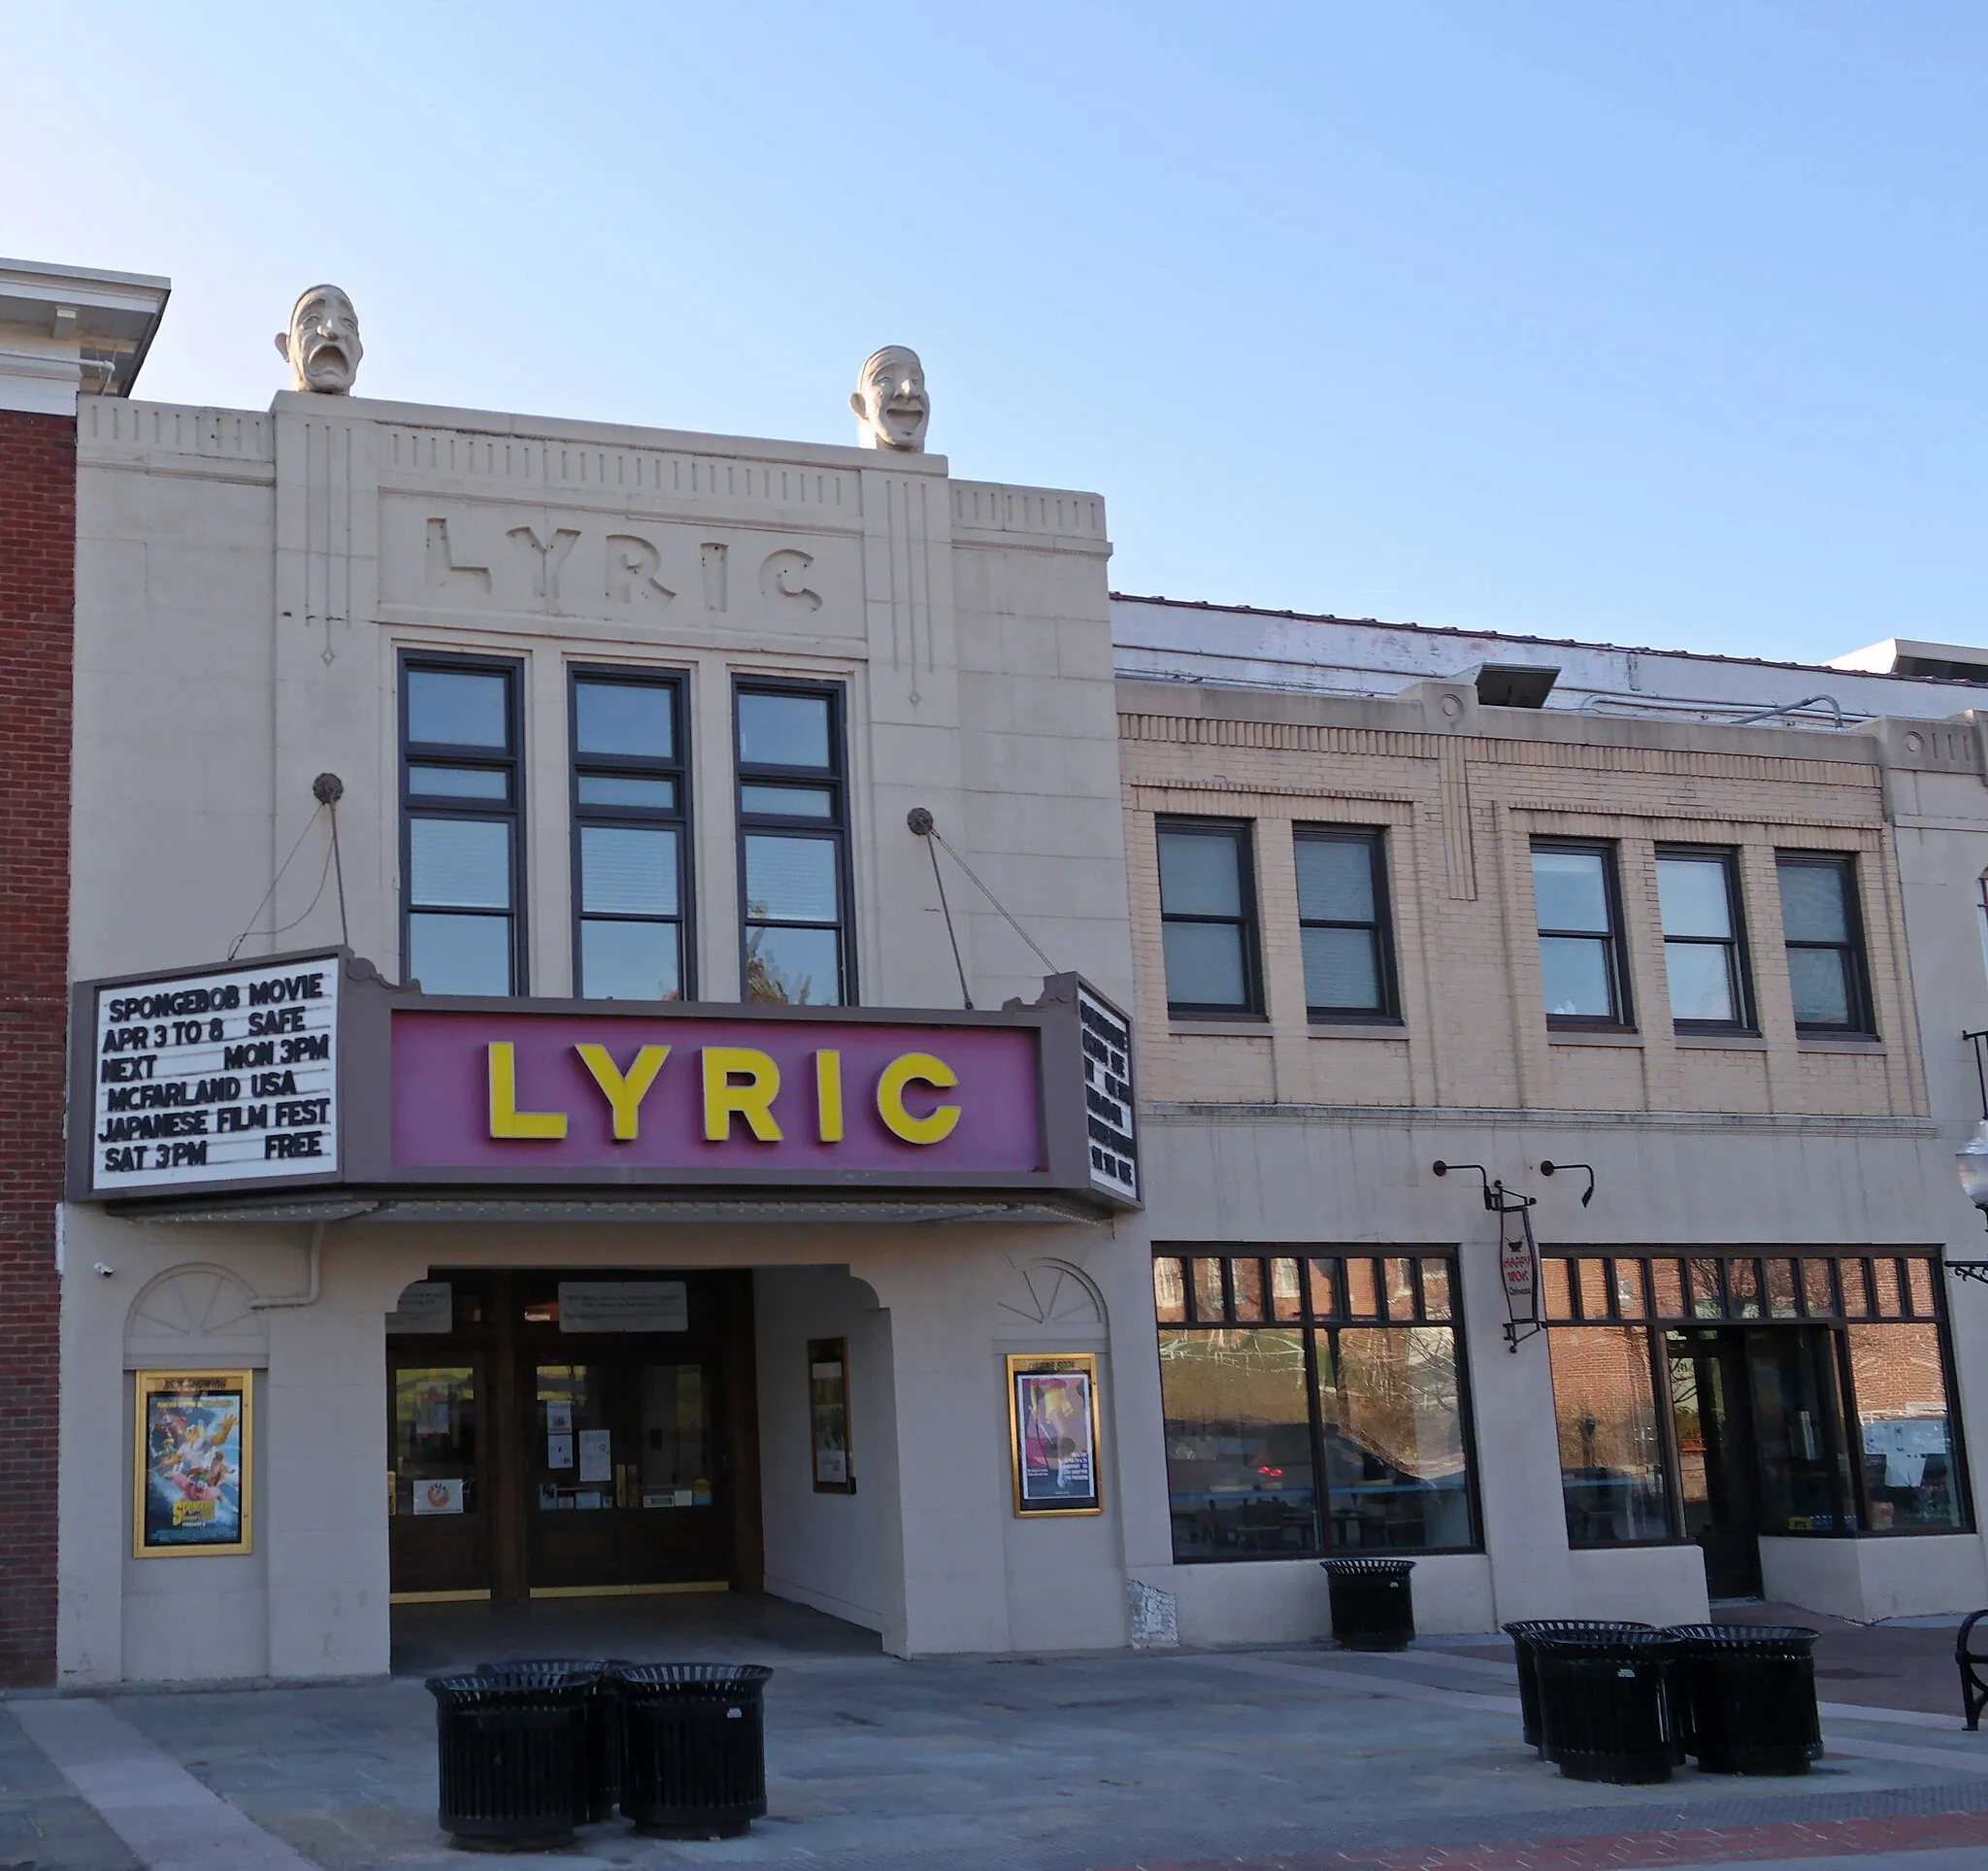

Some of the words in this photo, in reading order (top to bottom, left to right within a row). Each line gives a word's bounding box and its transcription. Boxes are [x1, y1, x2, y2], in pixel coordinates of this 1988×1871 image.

[425, 517, 823, 613] LYRIC
[109, 985, 240, 1022] SPONGEBOB
[248, 973, 323, 1006] MOVIE
[102, 1025, 149, 1053] APR
[153, 1024, 167, 1048] 3
[172, 1019, 202, 1046] TO
[209, 1018, 223, 1042] 8
[248, 1006, 306, 1036] SAFE
[101, 1054, 157, 1084] NEXT
[224, 1041, 274, 1070] MON
[107, 1077, 241, 1112] MCFARLAND
[251, 1070, 296, 1098] USA
[487, 1041, 962, 1145] LYRIC
[98, 1109, 208, 1143] JAPANESE
[216, 1104, 267, 1133] FILM
[275, 1098, 330, 1126] FEST
[105, 1146, 148, 1172] SAT
[264, 1131, 321, 1159] FREE
[1504, 1255, 1531, 1268] HAPPY
